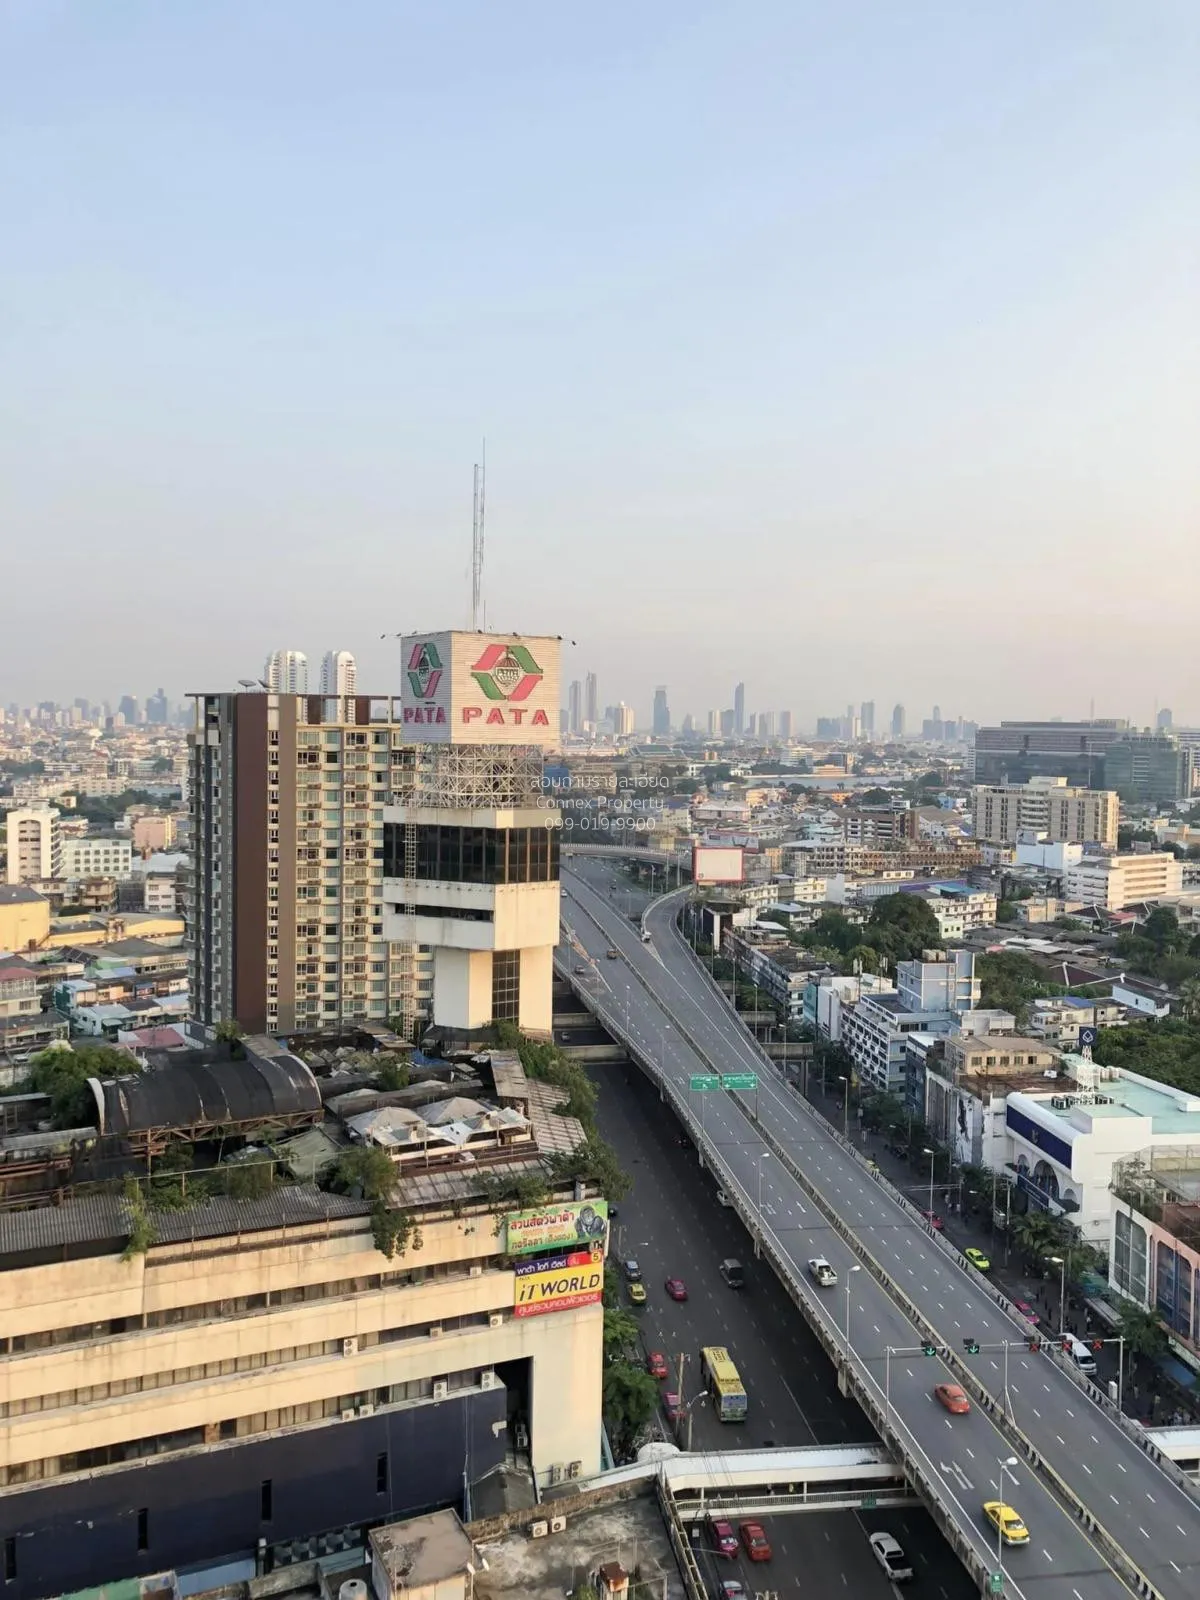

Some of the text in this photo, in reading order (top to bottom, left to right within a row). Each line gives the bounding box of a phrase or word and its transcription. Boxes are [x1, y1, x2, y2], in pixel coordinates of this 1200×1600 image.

[403, 706, 447, 724] PATA
[462, 706, 550, 725] PATA
[592, 1252, 600, 1262] 5
[541, 1274, 600, 1297] WORLD
